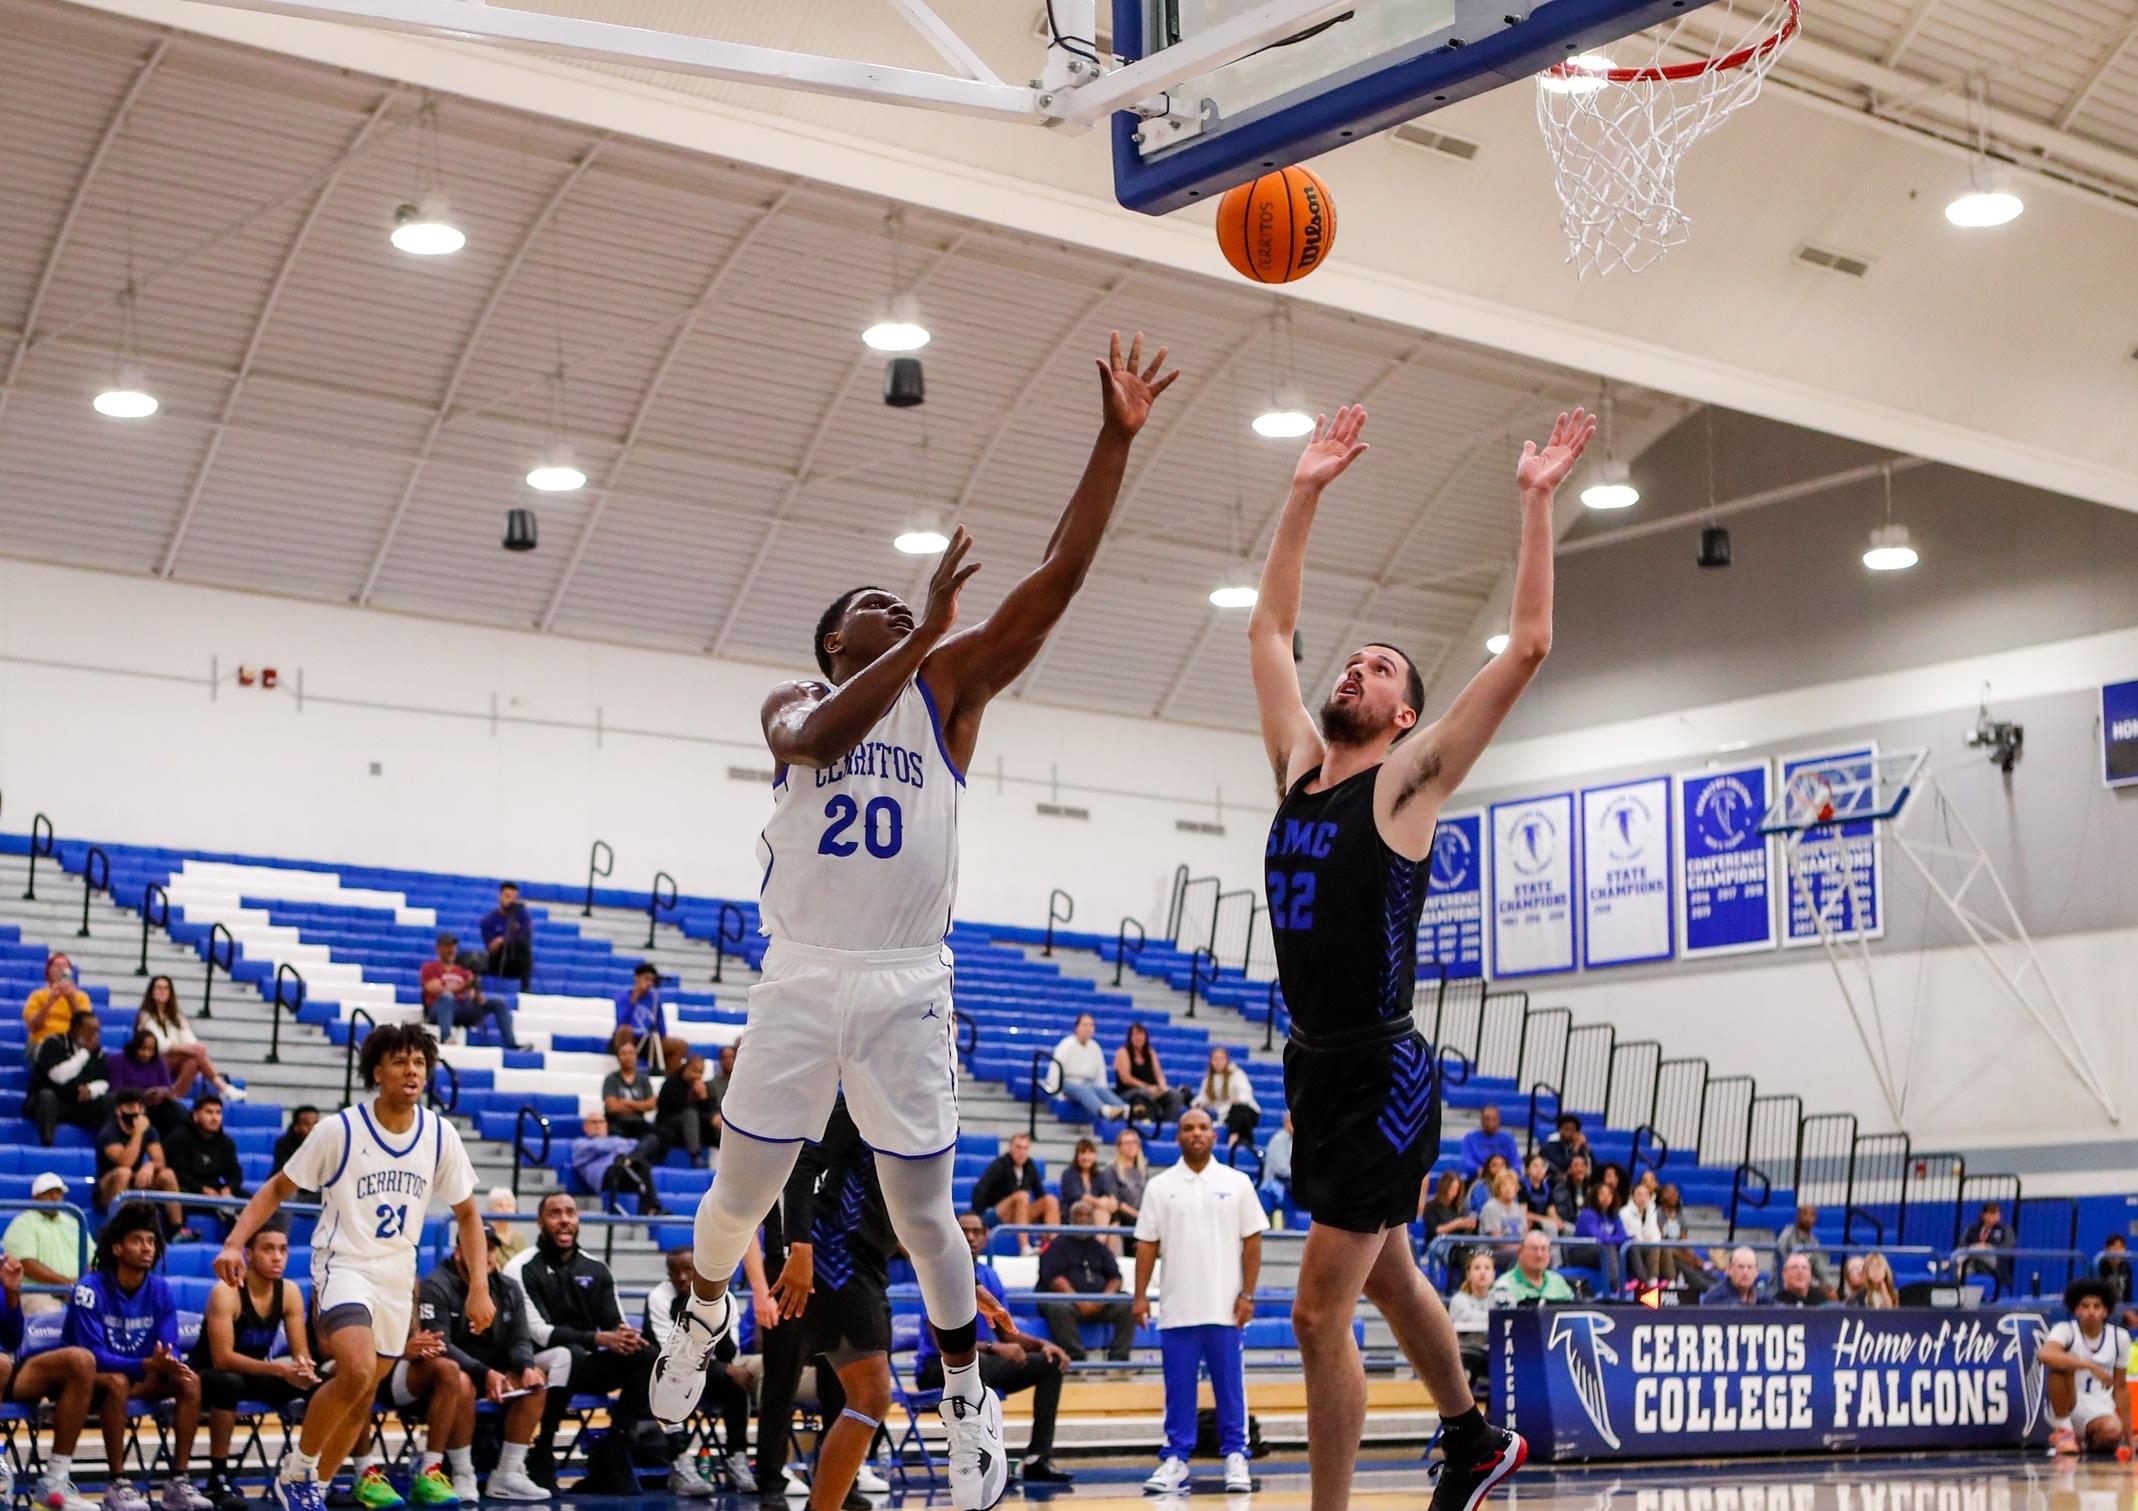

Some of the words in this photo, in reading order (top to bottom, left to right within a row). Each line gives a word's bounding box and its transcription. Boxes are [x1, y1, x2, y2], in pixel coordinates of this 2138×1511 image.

[1258, 202, 1274, 270] CERRITOS
[1297, 186, 1322, 269] Wilson
[815, 742, 923, 789] CERRITOS
[818, 794, 903, 859] 20
[1515, 880, 1553, 896] STATE
[1590, 880, 1665, 901] CHAMPIONS
[1606, 866, 1647, 885] STATE
[1687, 864, 1765, 891] CHAMPIONS
[1267, 871, 1316, 931] 22
[1500, 892, 1567, 913] CHAMPIONS
[357, 1170, 427, 1199] CERRITOS
[375, 1204, 408, 1239] 21
[1631, 1324, 1806, 1373] CERRITOS
[1833, 1317, 1917, 1368] Home
[1917, 1319, 1951, 1367] of
[1952, 1319, 2000, 1366] the
[1634, 1374, 1813, 1434] COLLEGE
[1833, 1368, 2009, 1428] FALCONS
